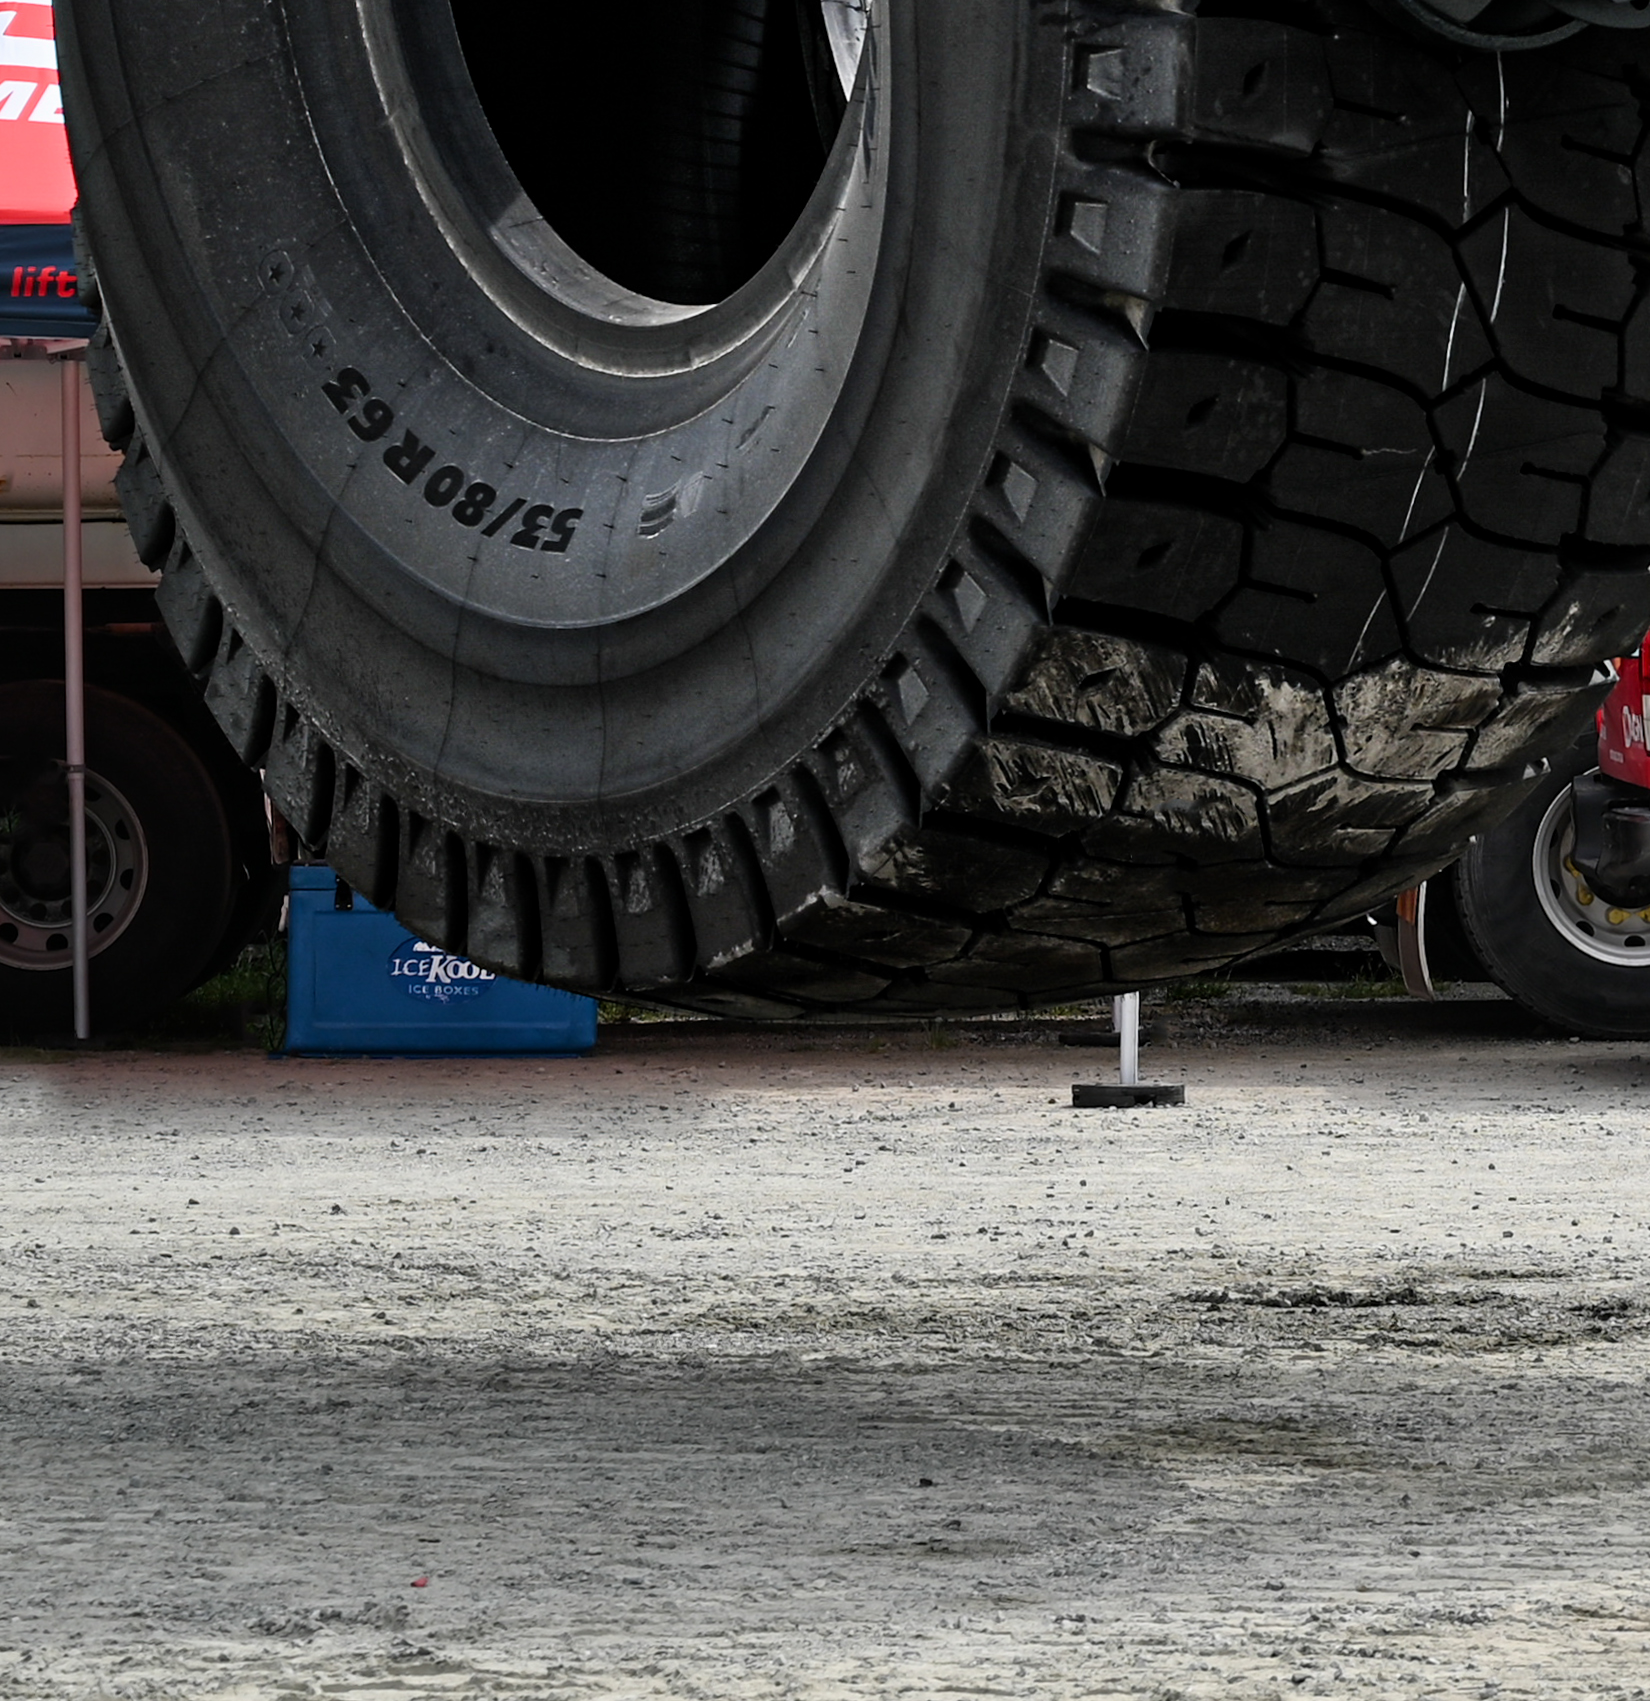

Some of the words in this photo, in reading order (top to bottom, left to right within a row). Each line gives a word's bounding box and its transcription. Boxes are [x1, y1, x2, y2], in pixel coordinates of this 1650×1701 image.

[11, 266, 78, 298] lift
[408, 984, 429, 994] ICE
[434, 985, 479, 996] BOXES
